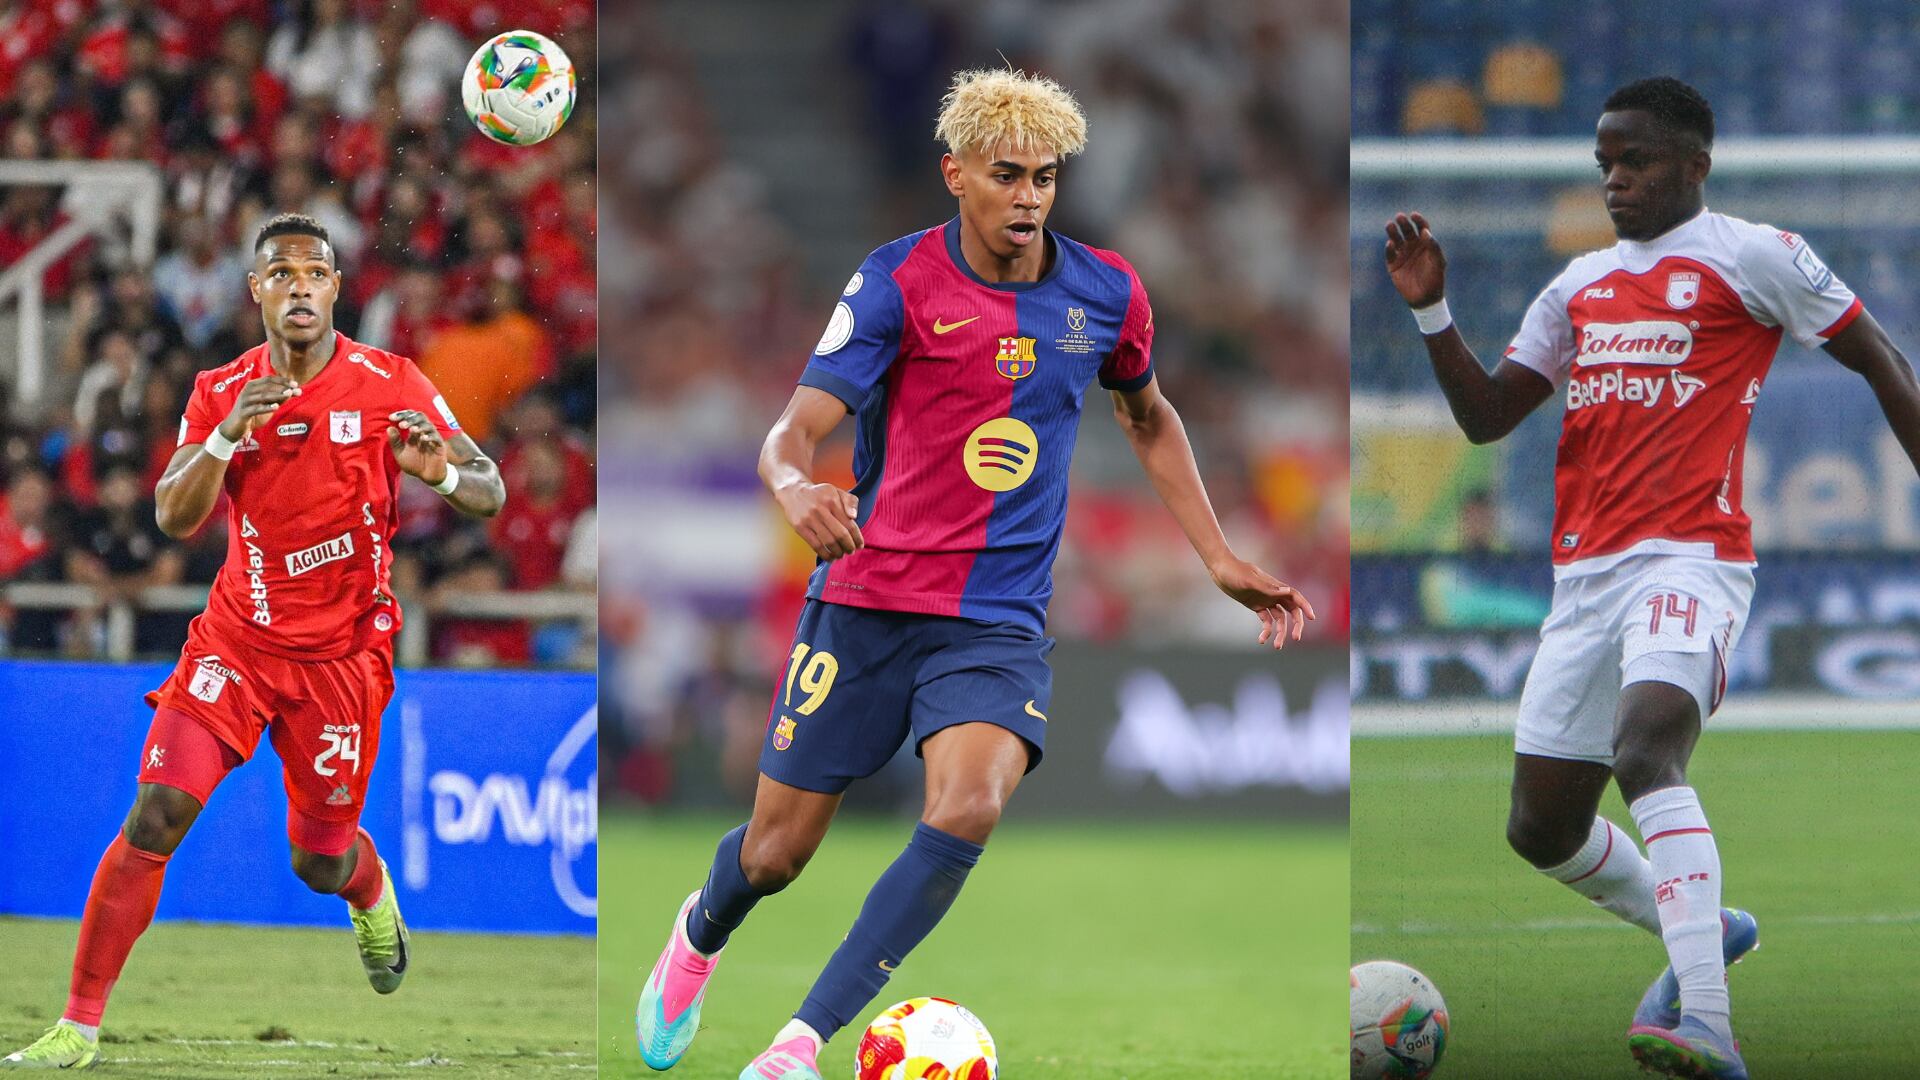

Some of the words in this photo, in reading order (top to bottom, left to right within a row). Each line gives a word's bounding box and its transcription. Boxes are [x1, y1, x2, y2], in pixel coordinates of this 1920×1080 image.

[1583, 288, 1615, 301] FILA
[1581, 331, 1688, 355] Colanta
[1567, 368, 1665, 410] BetPlay
[278, 425, 308, 435] Colanta
[292, 538, 350, 574] AGUILA
[244, 541, 272, 627] BetPlay
[1646, 593, 1698, 638] 14
[784, 642, 839, 716] 19
[313, 731, 361, 777] 24
